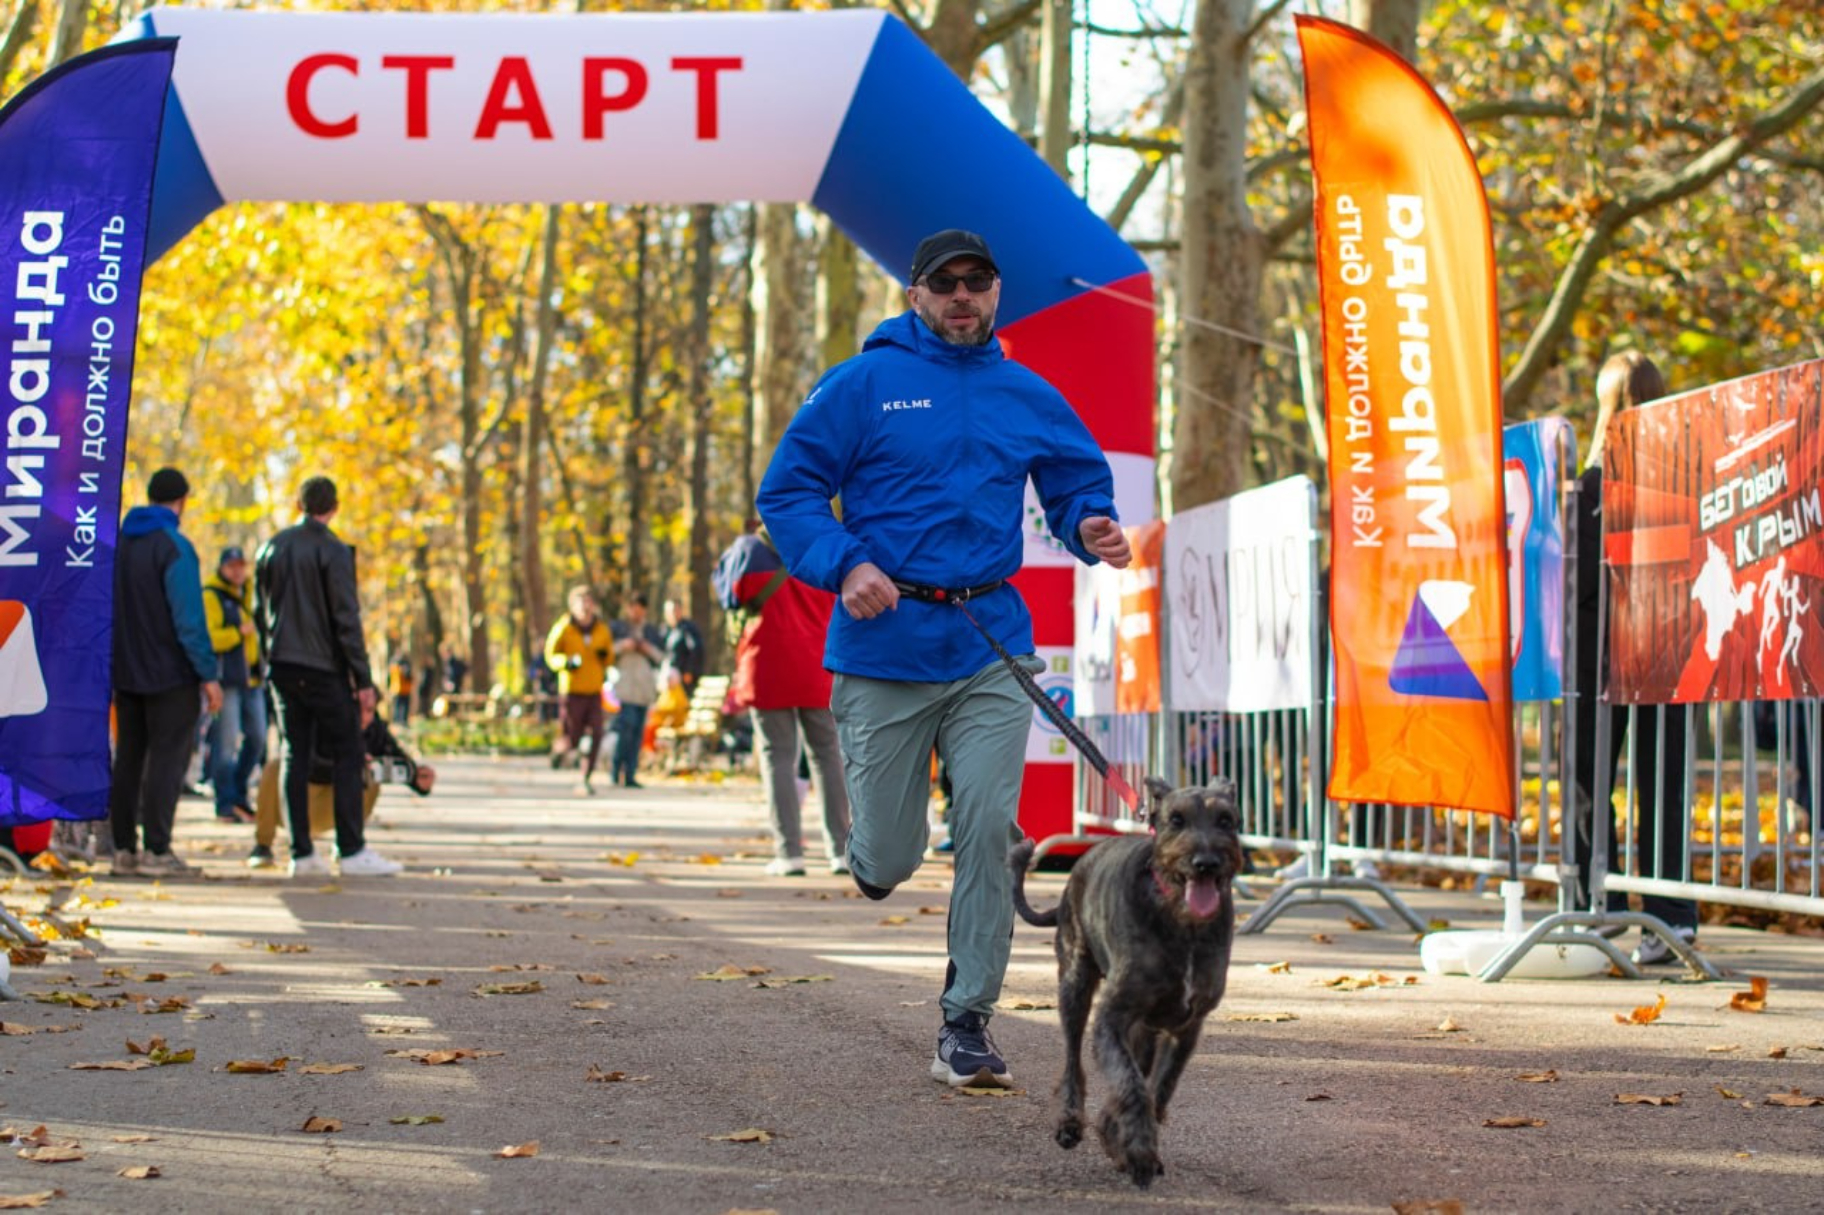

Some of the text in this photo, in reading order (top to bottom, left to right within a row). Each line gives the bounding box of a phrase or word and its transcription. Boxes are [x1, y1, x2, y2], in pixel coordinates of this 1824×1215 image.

[286, 52, 743, 140] СТАРТ
[0, 211, 68, 567] Миранда
[65, 214, 125, 567] Как и должно быть
[882, 399, 932, 411] KELME
[1701, 452, 1788, 531] БЕГОВОЙ
[1735, 487, 1823, 568] КРЫМ
